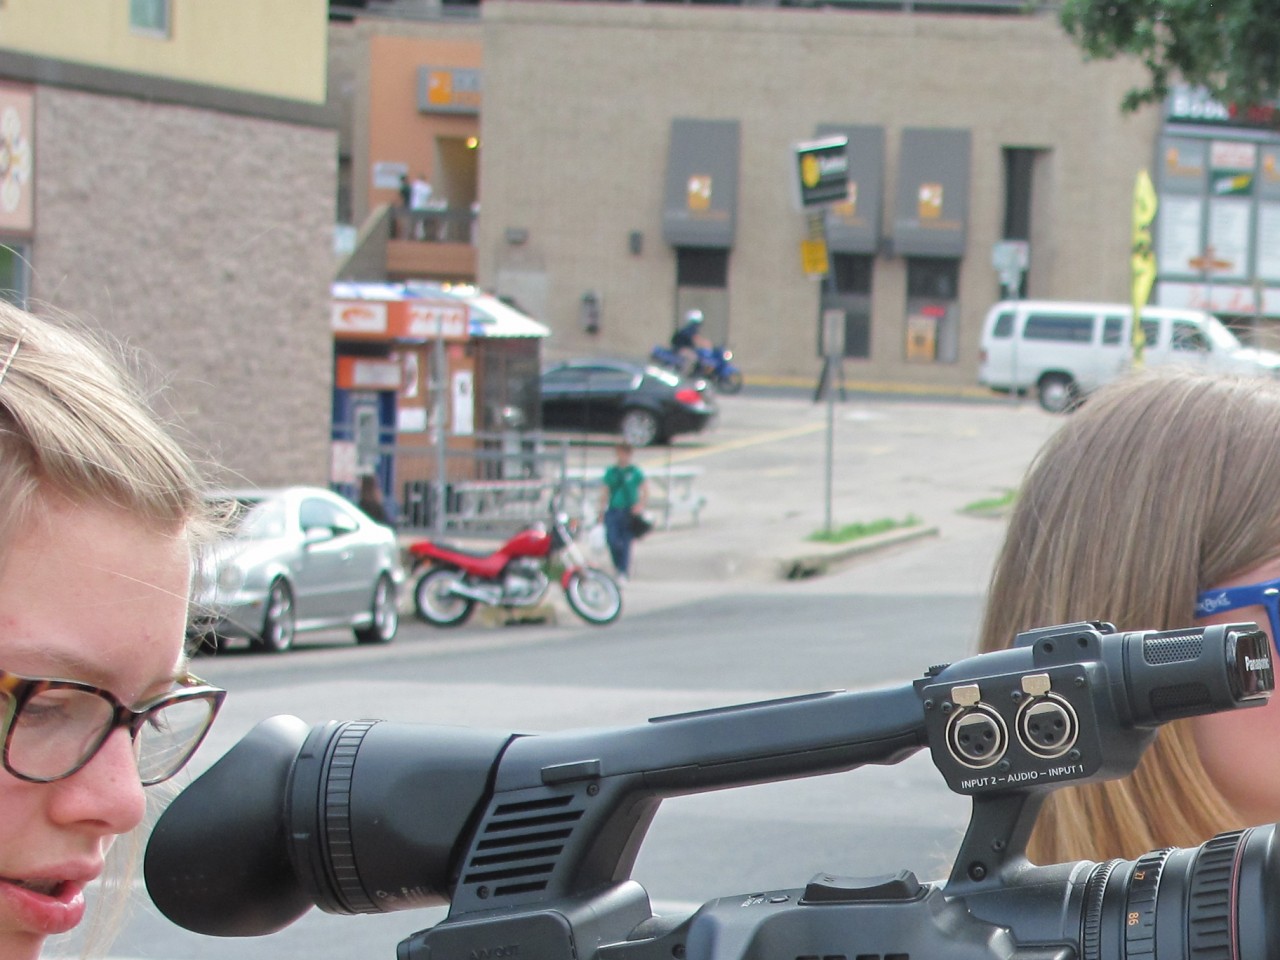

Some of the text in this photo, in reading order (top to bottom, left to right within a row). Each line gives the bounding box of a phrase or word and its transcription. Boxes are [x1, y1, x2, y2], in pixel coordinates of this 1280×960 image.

[961, 777, 989, 789] INPUT
[991, 776, 997, 785] 2
[1007, 770, 1038, 783] AUDIO
[1048, 765, 1076, 777] INPUT
[1079, 764, 1084, 773] 1
